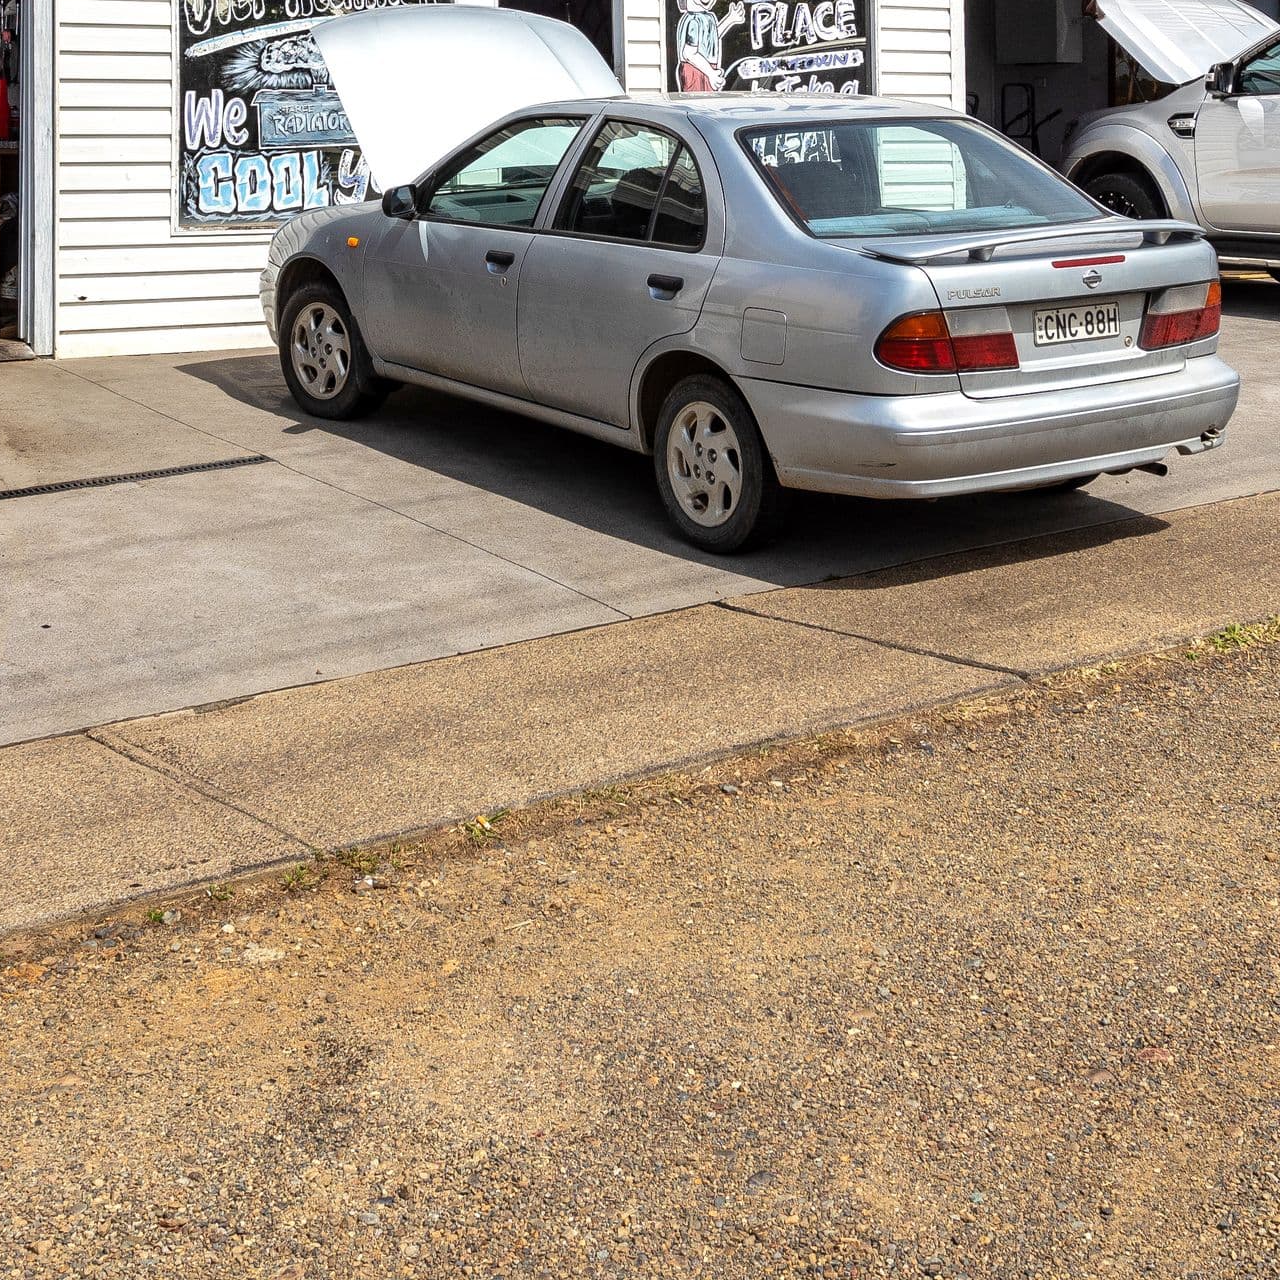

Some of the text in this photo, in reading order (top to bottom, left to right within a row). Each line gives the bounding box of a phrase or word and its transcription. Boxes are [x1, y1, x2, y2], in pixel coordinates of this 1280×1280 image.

[750, 0, 857, 50] PLACE
[184, 89, 249, 150] We
[272, 110, 352, 137] RADIATOR
[198, 151, 330, 213] COOL
[947, 287, 1001, 300] PULSAR
